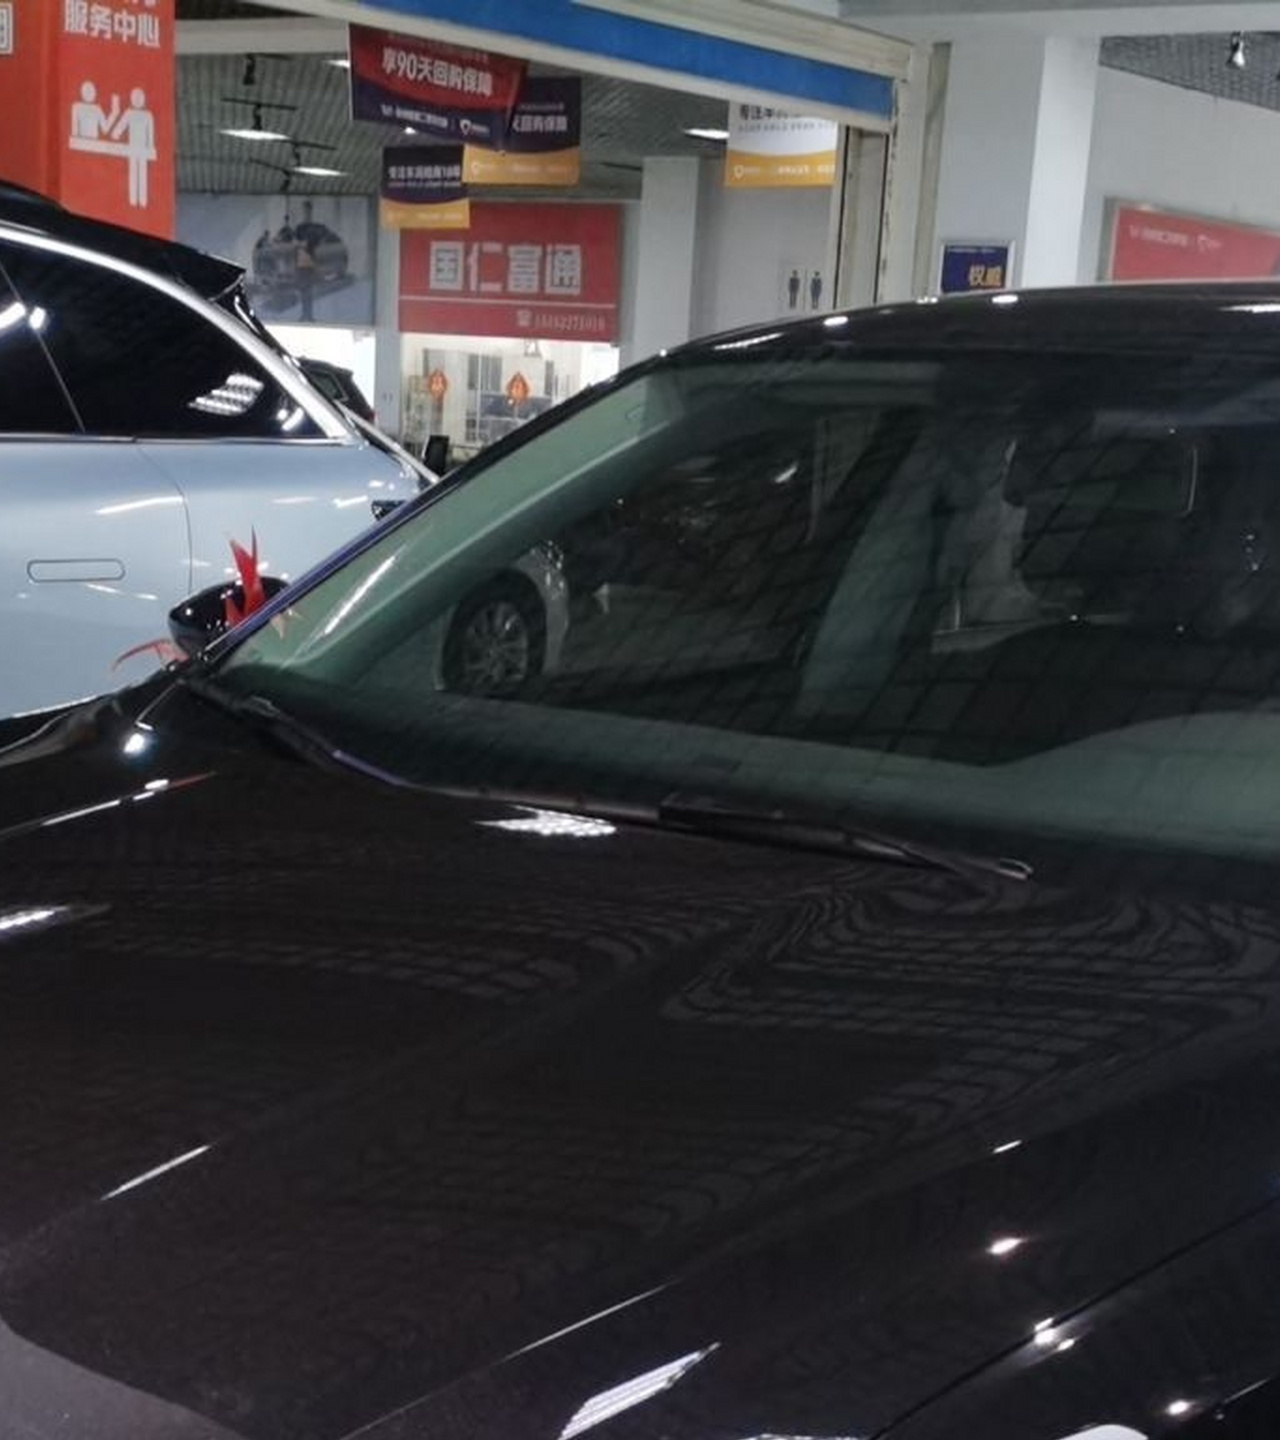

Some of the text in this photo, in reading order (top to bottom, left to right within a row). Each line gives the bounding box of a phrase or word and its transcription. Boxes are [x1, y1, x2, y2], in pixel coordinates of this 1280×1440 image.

[64, 0, 160, 47] 服务中心
[382, 46, 493, 97] 享90天回购保障
